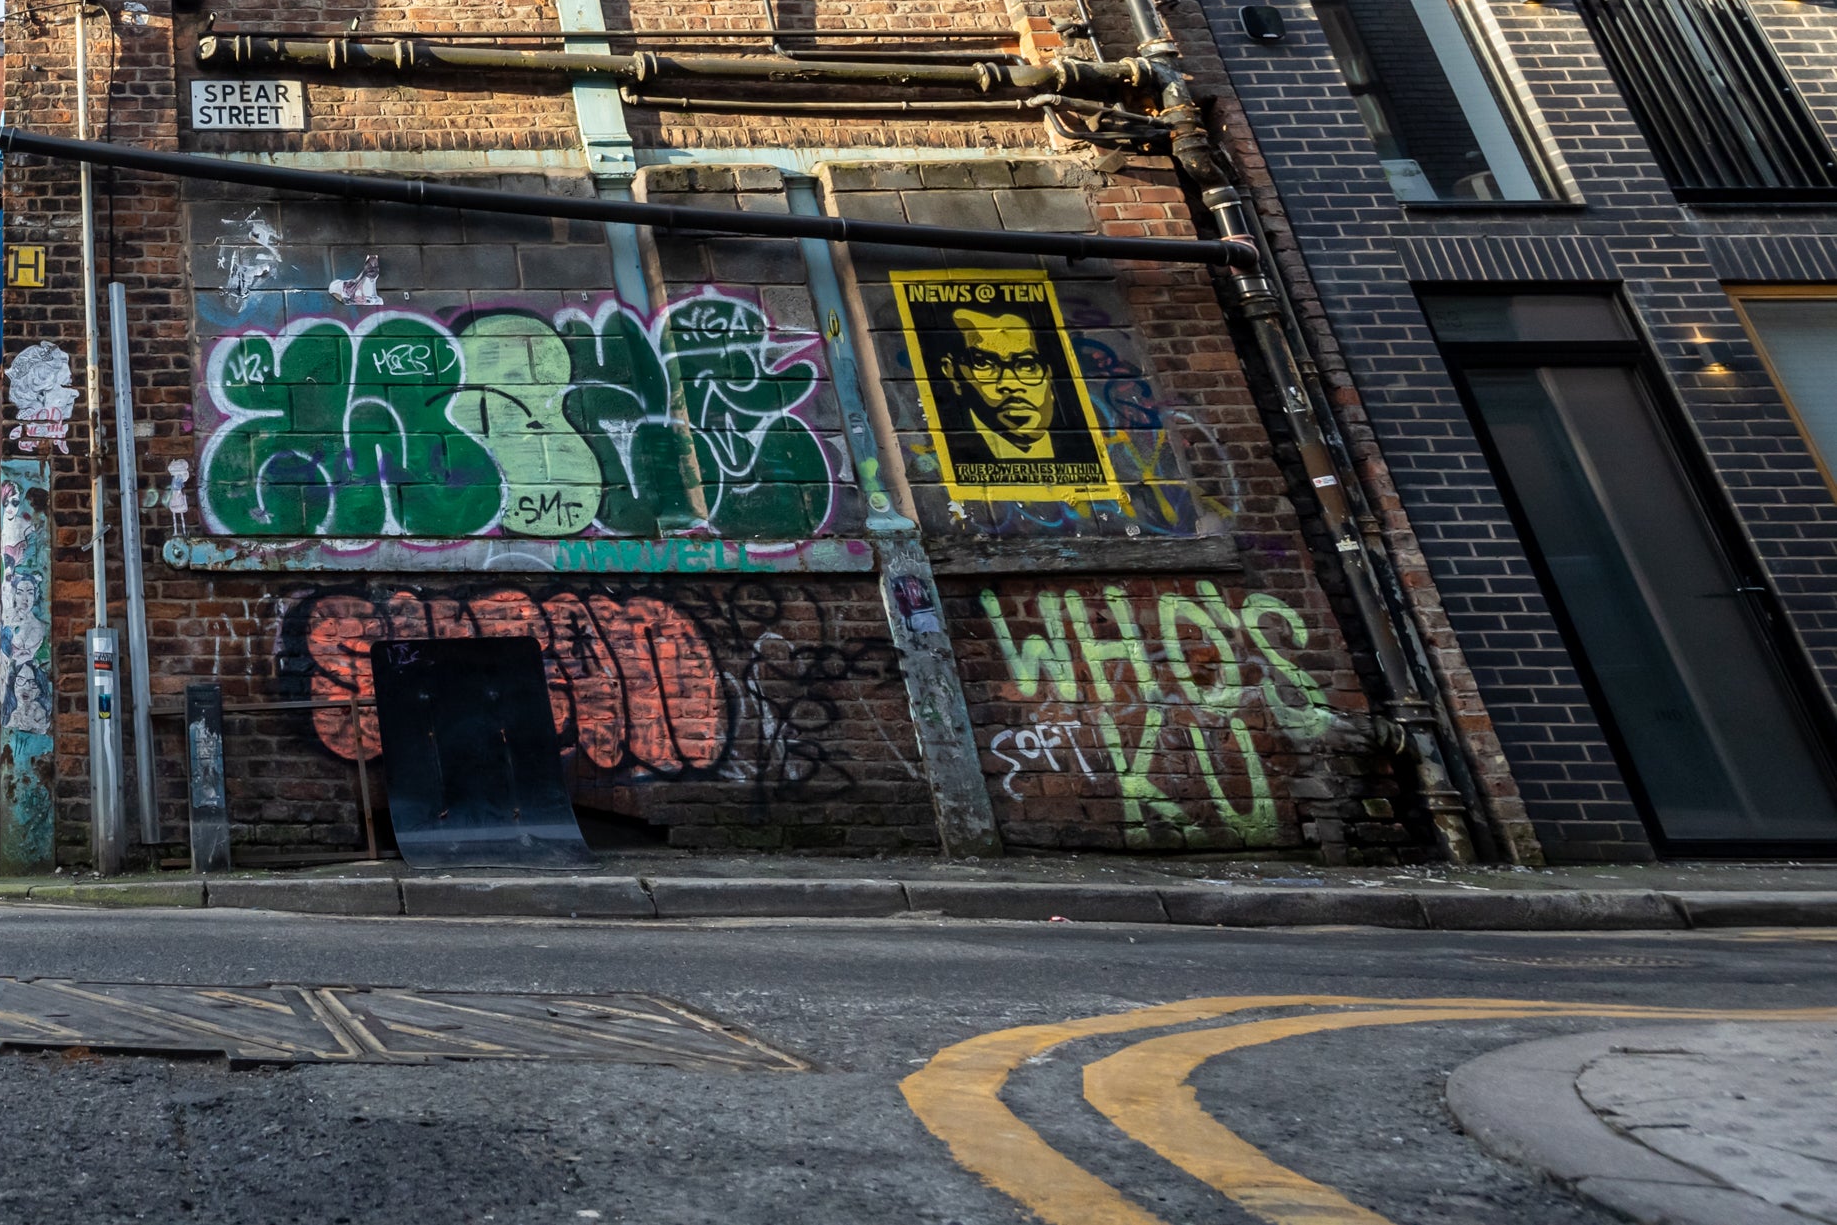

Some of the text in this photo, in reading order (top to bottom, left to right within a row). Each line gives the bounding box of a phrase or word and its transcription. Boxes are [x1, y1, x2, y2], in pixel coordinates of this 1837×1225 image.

[204, 84, 290, 103] SPEAR
[199, 105, 283, 124] STREET
[13, 250, 40, 282] H
[908, 283, 1045, 303] NEWS @ TEN
[955, 463, 1098, 474] TRUE POWER LIES WITHIN
[990, 720, 1097, 801] SOFT
